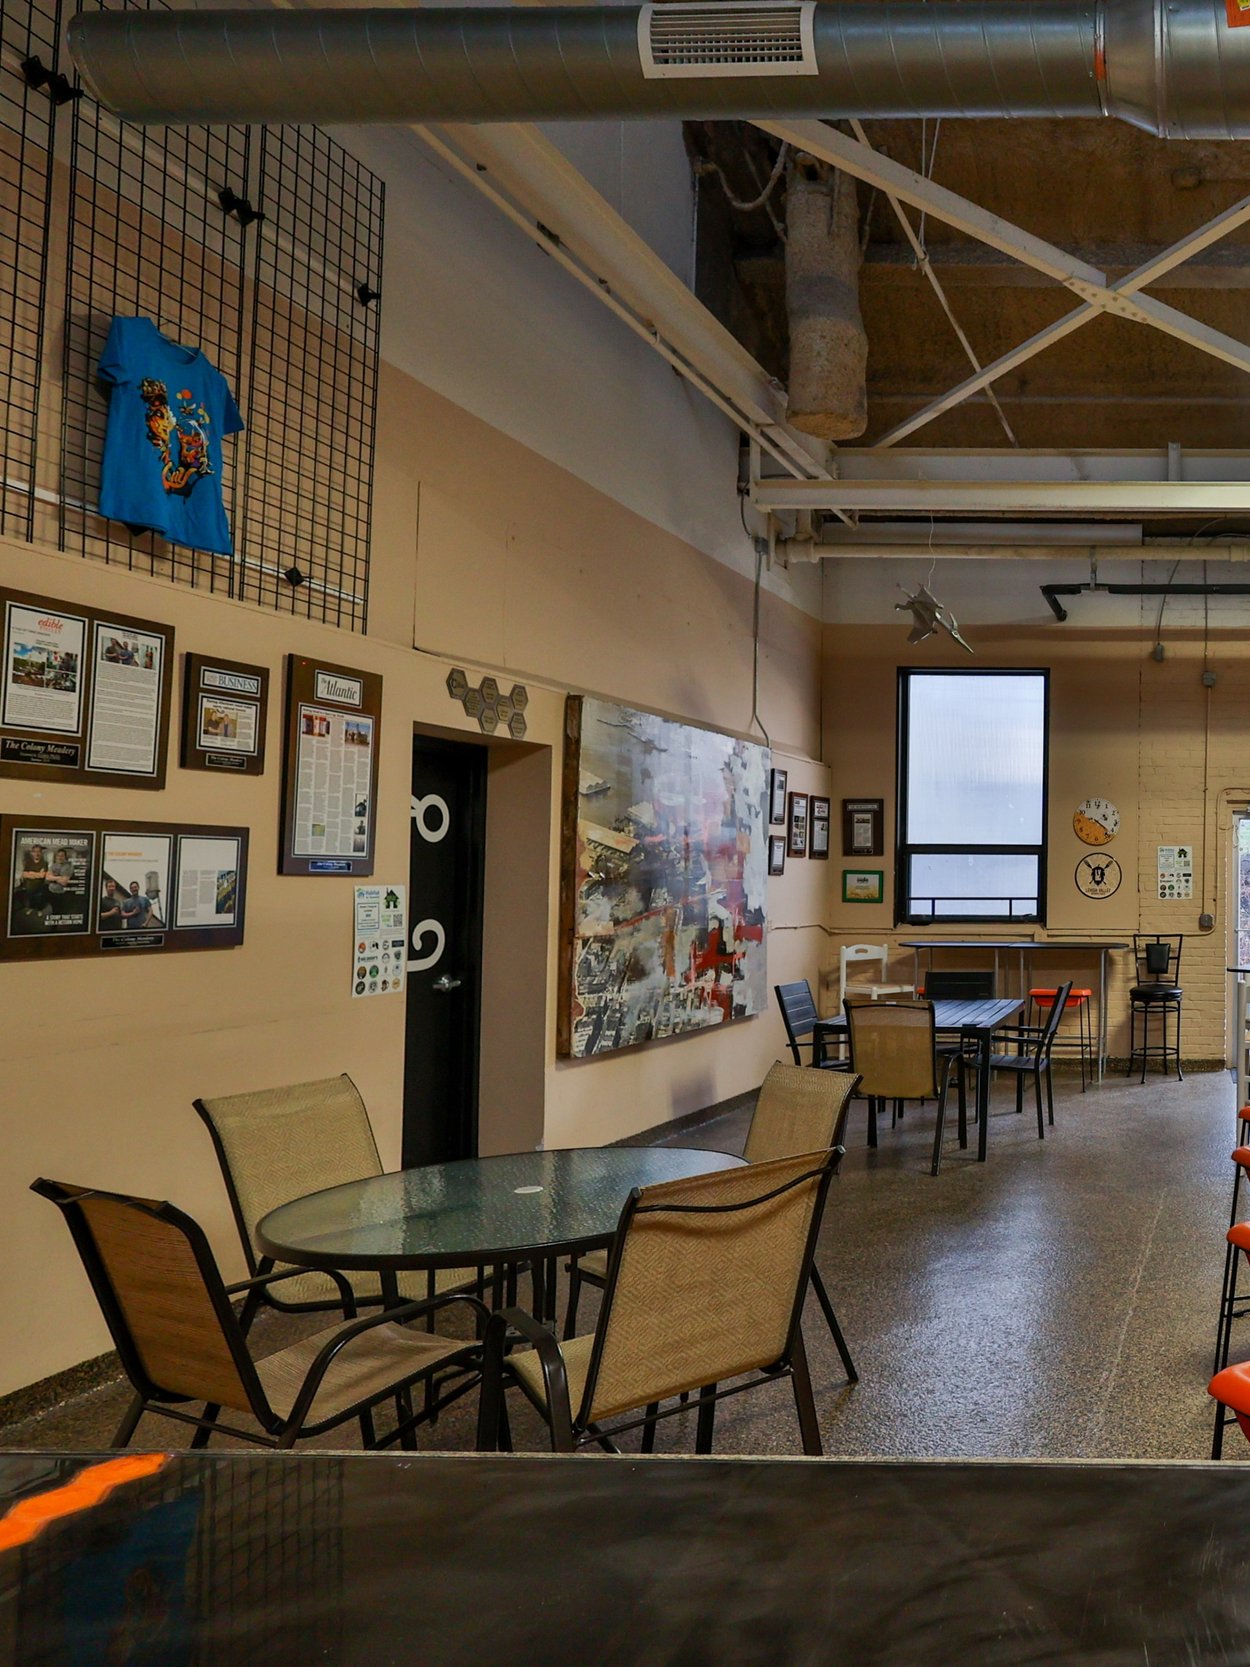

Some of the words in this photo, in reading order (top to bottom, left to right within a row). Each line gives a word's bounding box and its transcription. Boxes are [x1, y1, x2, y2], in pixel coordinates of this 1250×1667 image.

[37, 617, 64, 631] edible
[218, 675, 258, 692] BUSINESS
[321, 679, 358, 701] Atlantic
[5, 740, 20, 750] The
[21, 742, 46, 753] Colony
[47, 745, 76, 757] Meadery
[20, 837, 52, 846] AMERICAN
[52, 838, 68, 846] MEAD
